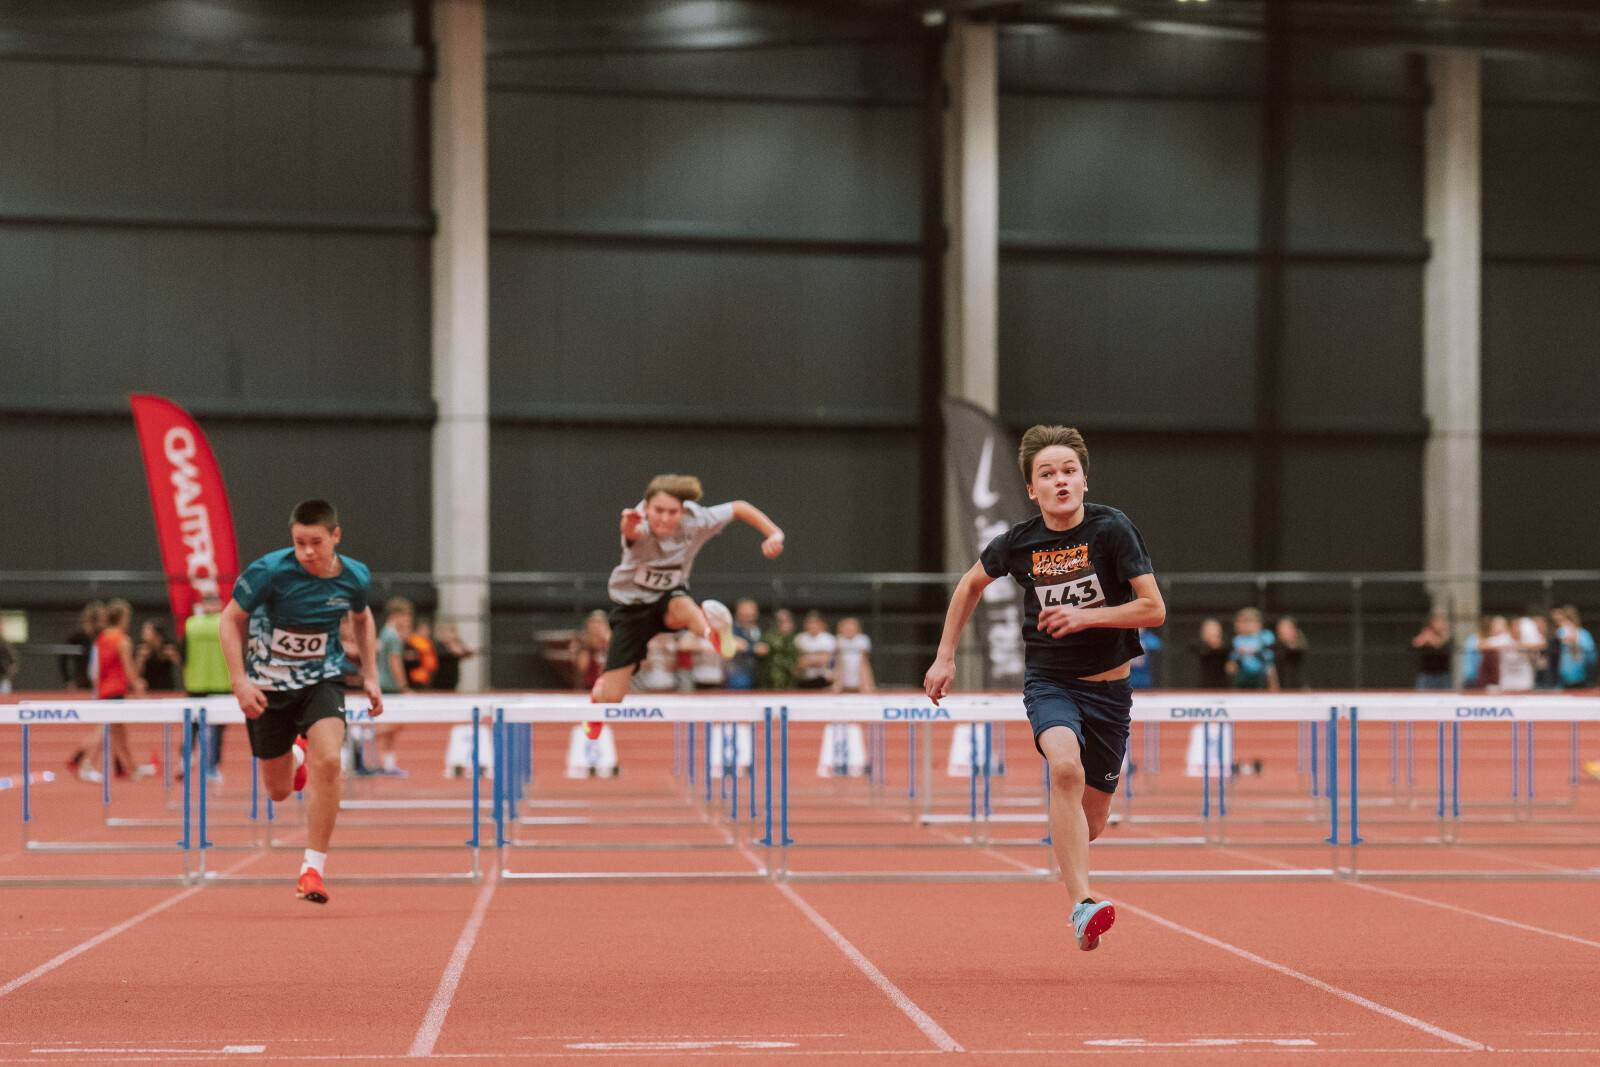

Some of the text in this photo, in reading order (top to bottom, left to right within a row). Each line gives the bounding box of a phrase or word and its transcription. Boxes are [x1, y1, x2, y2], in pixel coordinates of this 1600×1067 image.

[645, 571, 672, 586] 175
[1045, 580, 1098, 606] 443
[277, 635, 322, 653] 430
[19, 709, 80, 720] DIMA
[605, 707, 663, 718] DIMA
[884, 707, 950, 719] DIMA
[1171, 707, 1229, 718] DIMA
[1456, 707, 1513, 717] DIMA
